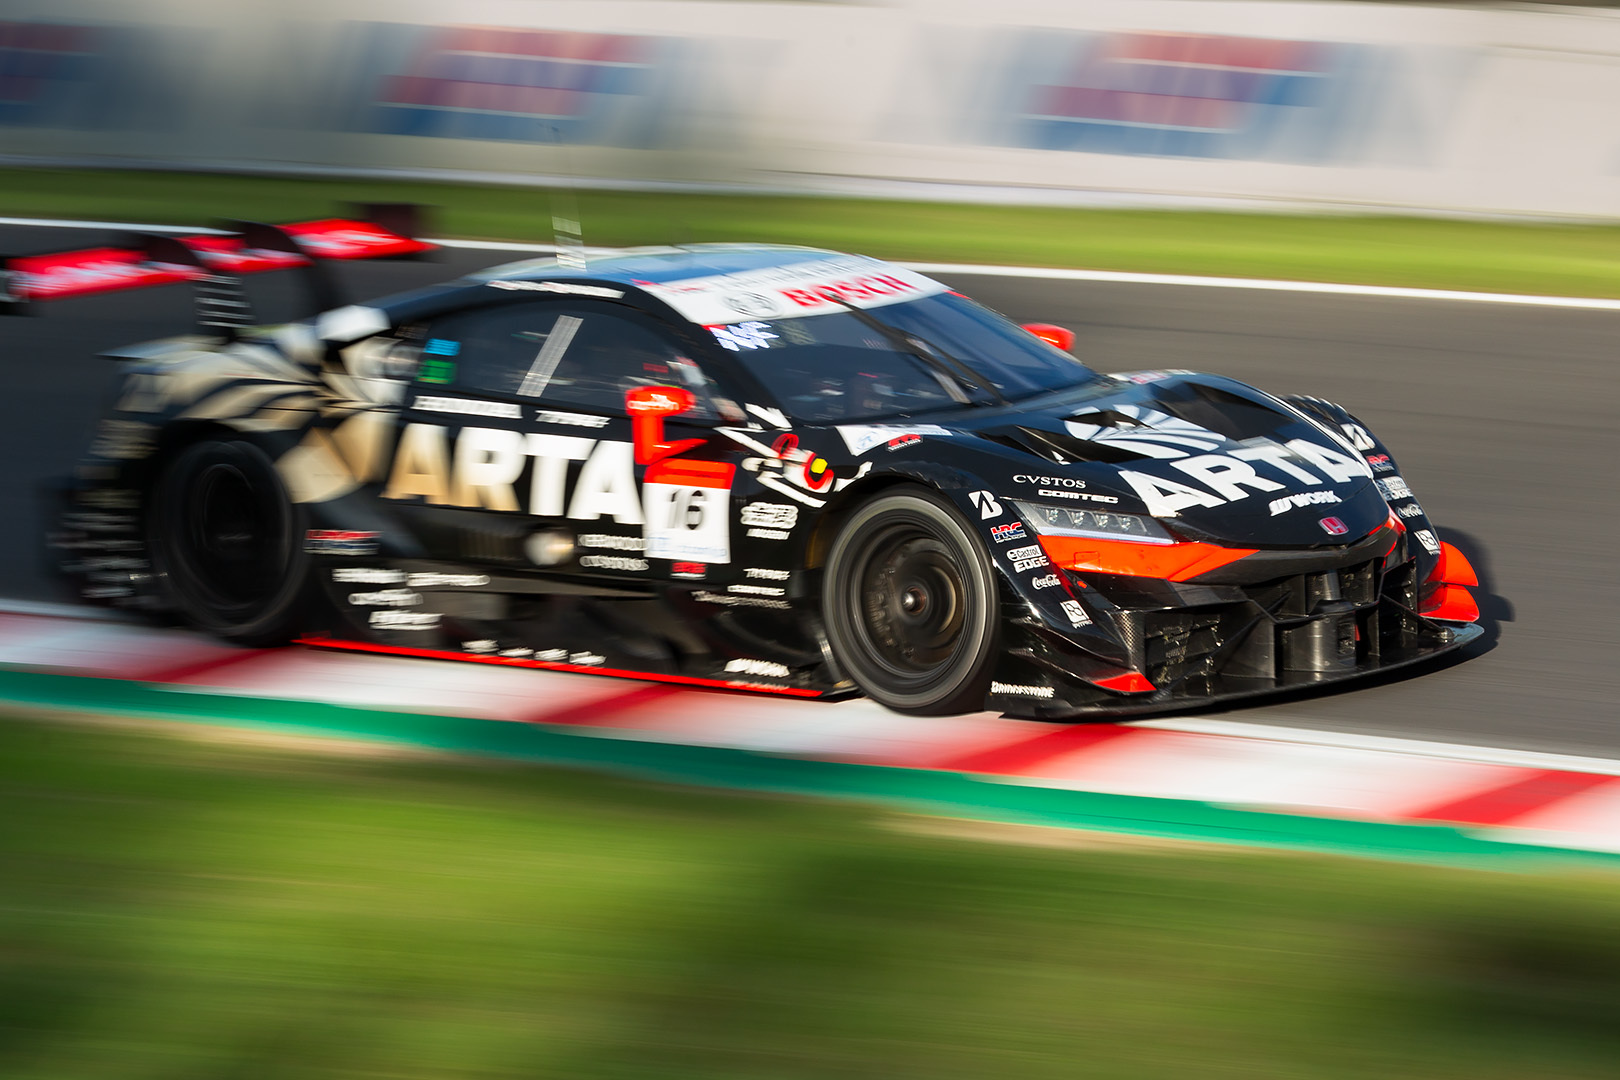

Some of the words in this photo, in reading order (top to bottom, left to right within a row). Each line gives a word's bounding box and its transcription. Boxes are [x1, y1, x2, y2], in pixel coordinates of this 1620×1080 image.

[777, 273, 921, 308] BOSCH
[379, 422, 646, 525] ARTA
[1012, 474, 1087, 489] CVSTOS
[1118, 438, 1373, 518] ARTA
[668, 489, 707, 530] 16
[1038, 489, 1119, 504] COMTEC
[1013, 556, 1049, 573] EDGE
[1016, 547, 1040, 558] Castrol
